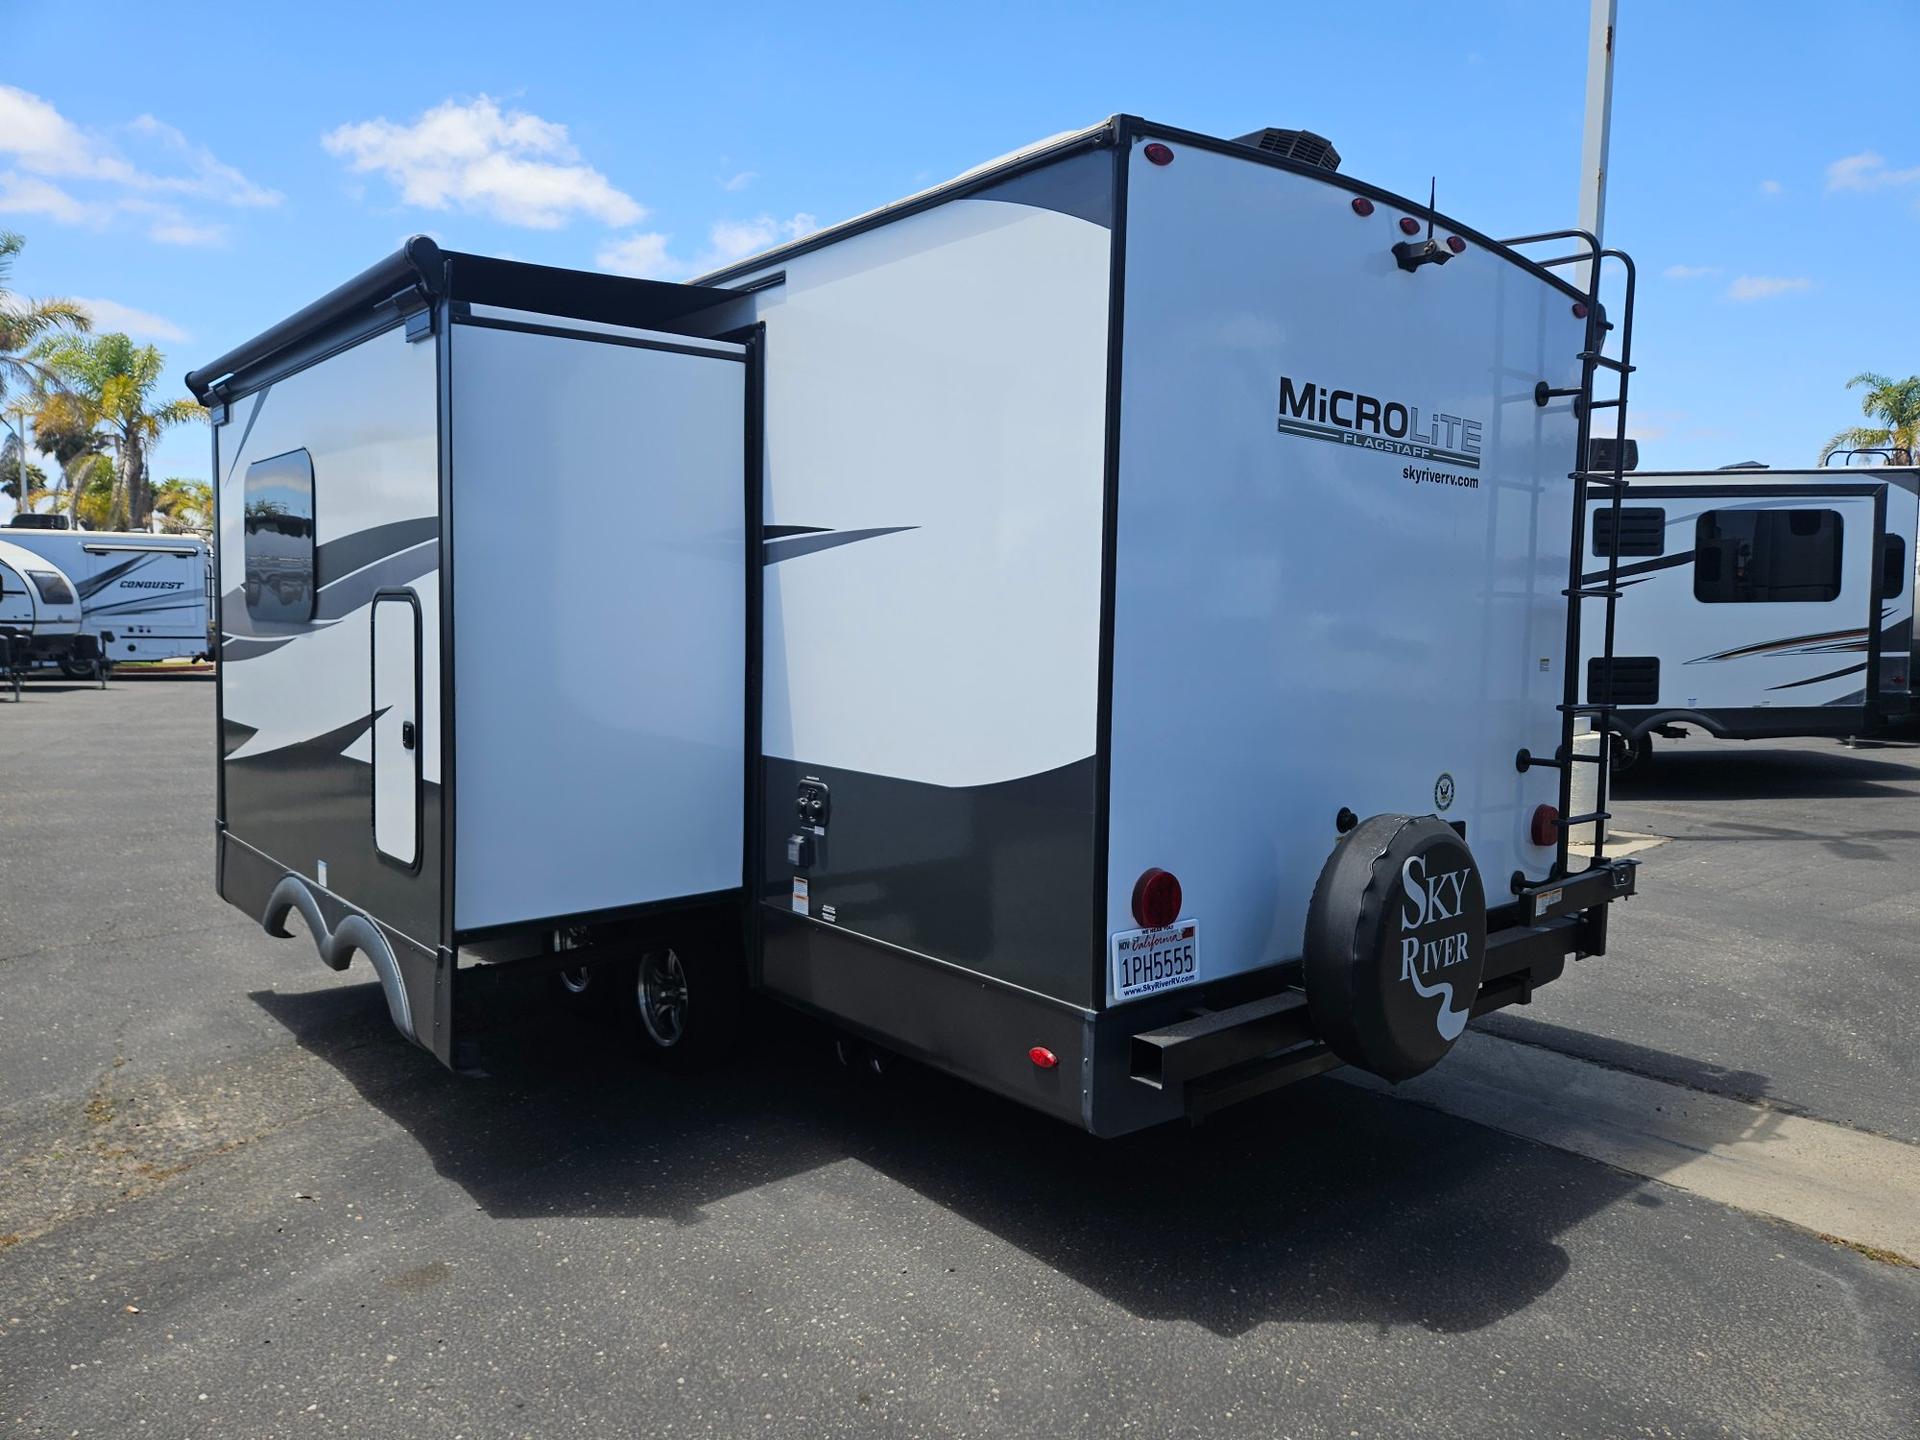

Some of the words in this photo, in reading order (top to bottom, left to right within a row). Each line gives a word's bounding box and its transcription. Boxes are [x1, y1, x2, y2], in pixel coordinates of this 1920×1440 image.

[1343, 432, 1431, 458] FLAGSTAFF
[1402, 464, 1480, 489] skyriverrv.com
[119, 580, 185, 590] CONQUEST
[1402, 854, 1472, 932] SKY
[1131, 933, 1179, 952] California
[1122, 945, 1194, 988] 1PH5555
[1399, 932, 1469, 981] RIVER
[1123, 974, 1196, 997] www.SkyRiverRV.com
